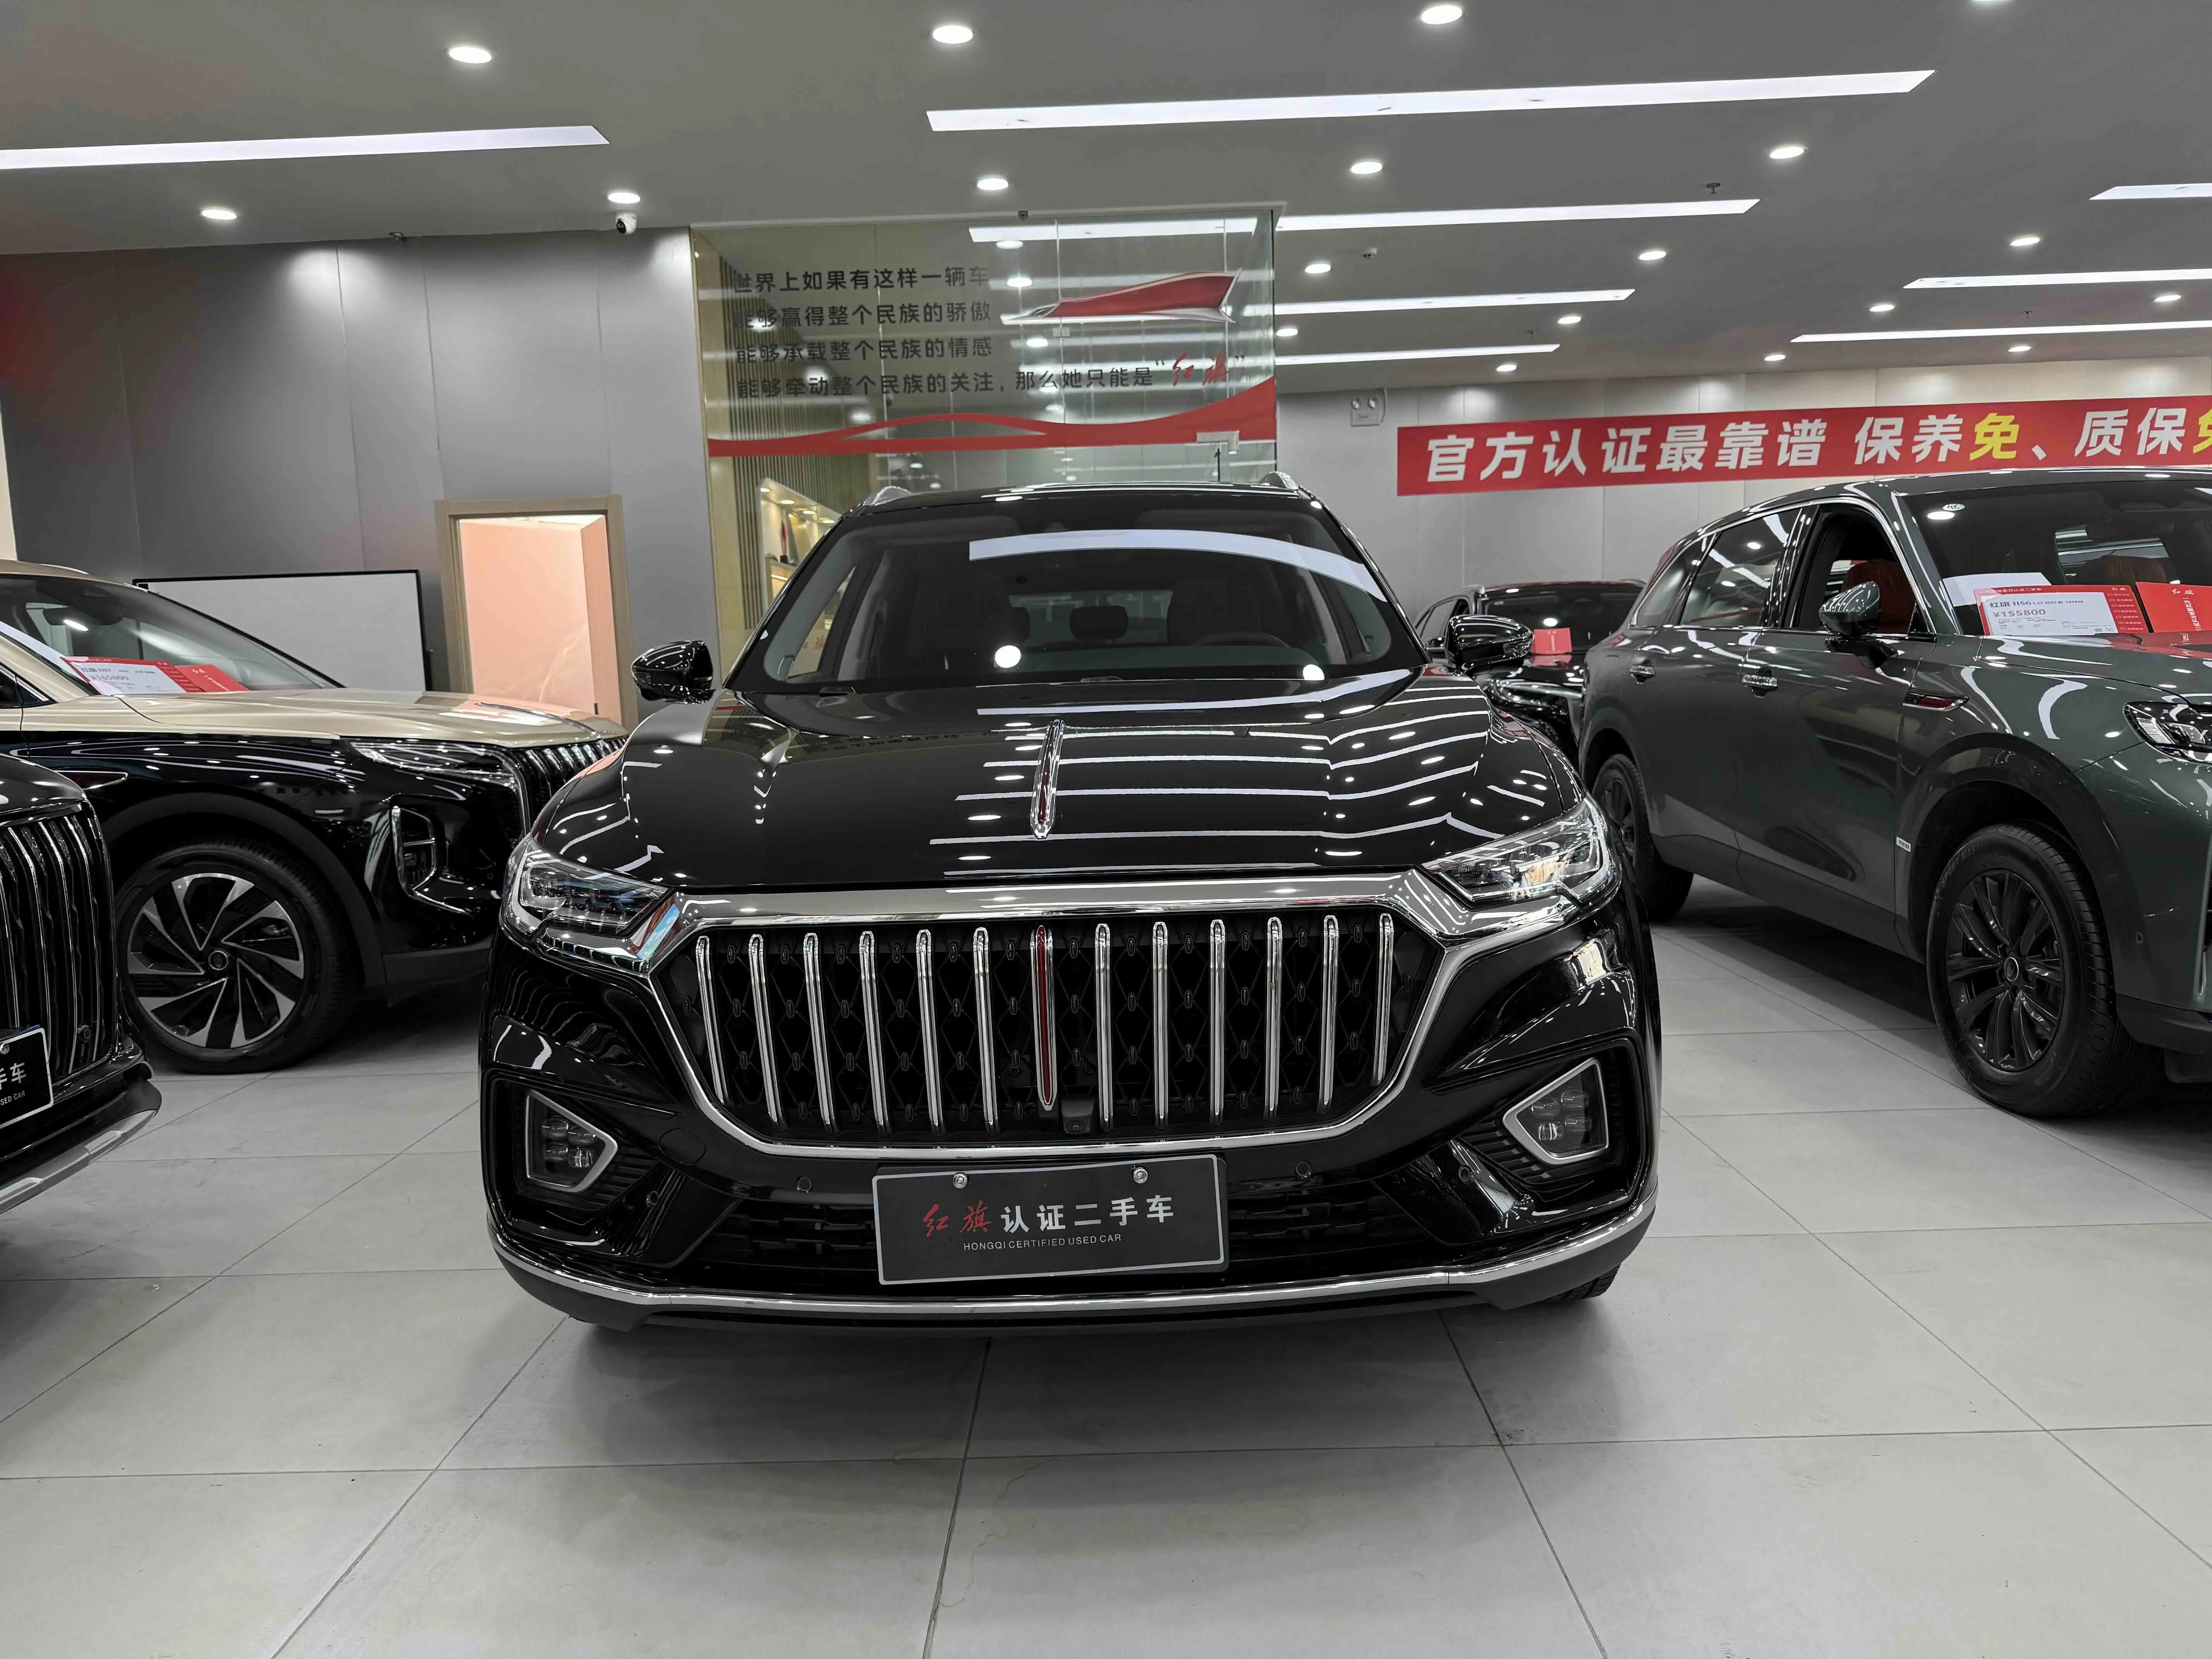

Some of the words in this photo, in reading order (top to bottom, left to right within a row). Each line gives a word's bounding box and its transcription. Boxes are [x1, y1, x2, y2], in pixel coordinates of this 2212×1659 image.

[734, 266, 989, 293] 世界上如果有这样一辆车
[734, 301, 991, 328] 能够赢得整个民族的骄傲
[736, 337, 993, 363] 能够承载整个民族的情感
[1426, 418, 1827, 483] 官方认证最靠谱
[1993, 609, 2046, 618] ¥155800
[0, 1096, 12, 1106] SED
[963, 1241, 1006, 1251] HONGQI
[1008, 1238, 1065, 1249] CERTIFIED
[1068, 1235, 1097, 1245] USED
[1099, 1233, 1121, 1243] CAR
